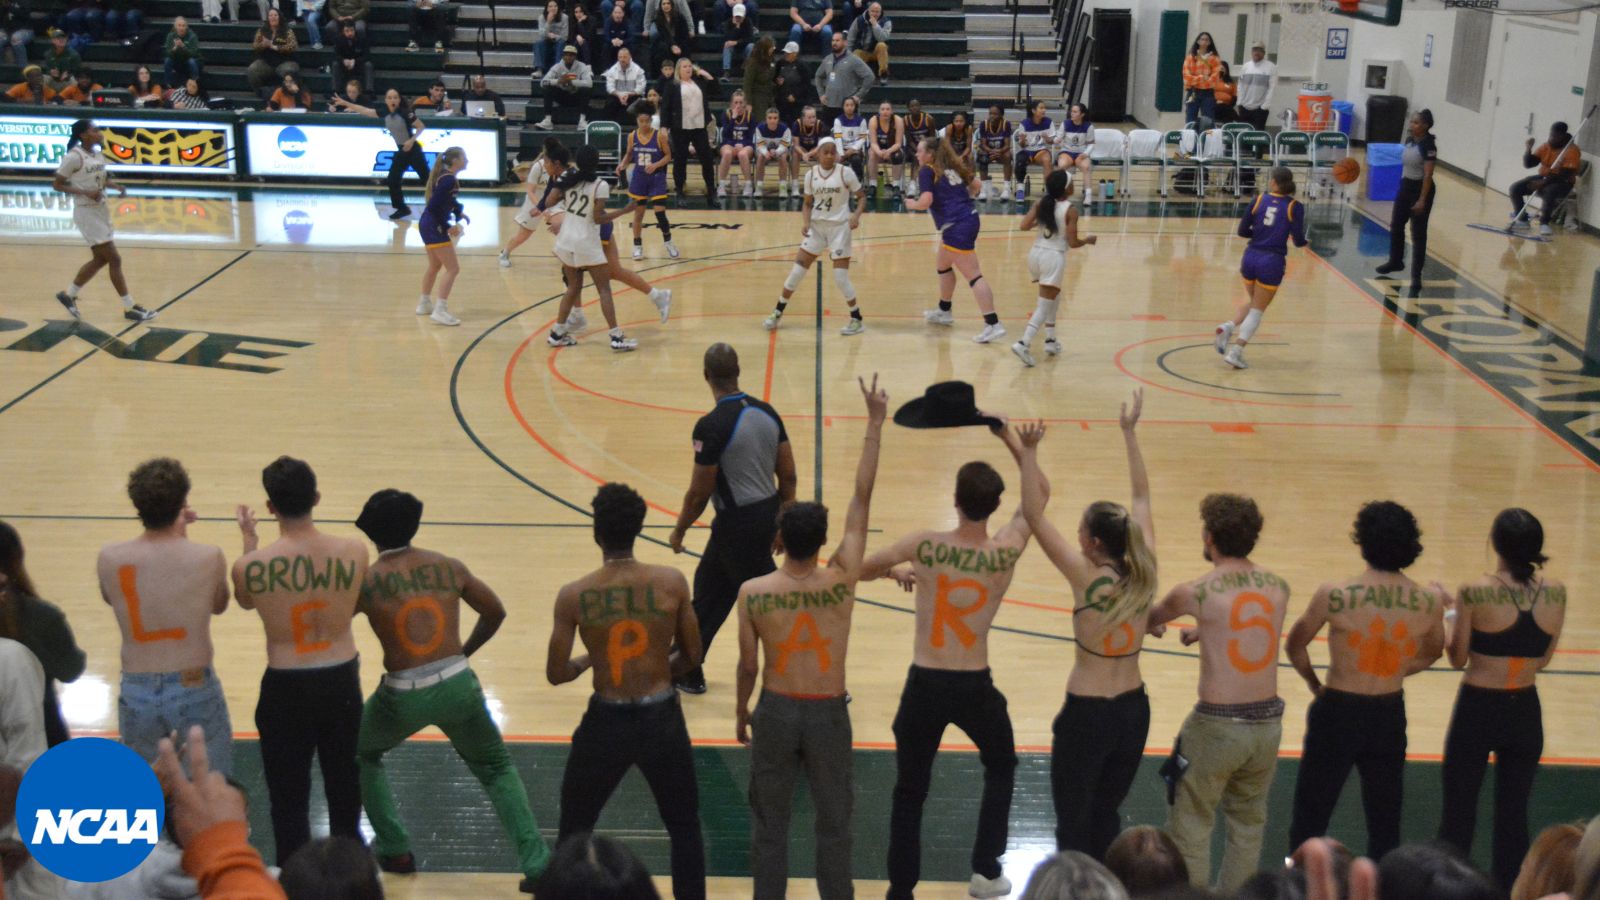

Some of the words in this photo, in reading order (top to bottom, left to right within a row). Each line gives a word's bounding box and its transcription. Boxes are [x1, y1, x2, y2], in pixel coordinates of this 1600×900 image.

[1327, 49, 1345, 57] EXIT
[34, 125, 47, 135] OF
[566, 190, 589, 218] 22
[815, 197, 833, 212] 24
[1263, 206, 1278, 227] 5
[0, 317, 316, 374] NE
[244, 555, 356, 594] BROWN
[118, 563, 188, 643] L
[579, 584, 670, 624] BELL
[930, 574, 989, 650] R
[1327, 584, 1436, 613] STANLEY
[290, 600, 332, 654] E
[395, 596, 446, 657] O
[774, 612, 832, 676] A
[1227, 592, 1277, 674] S
[607, 619, 649, 689] P
